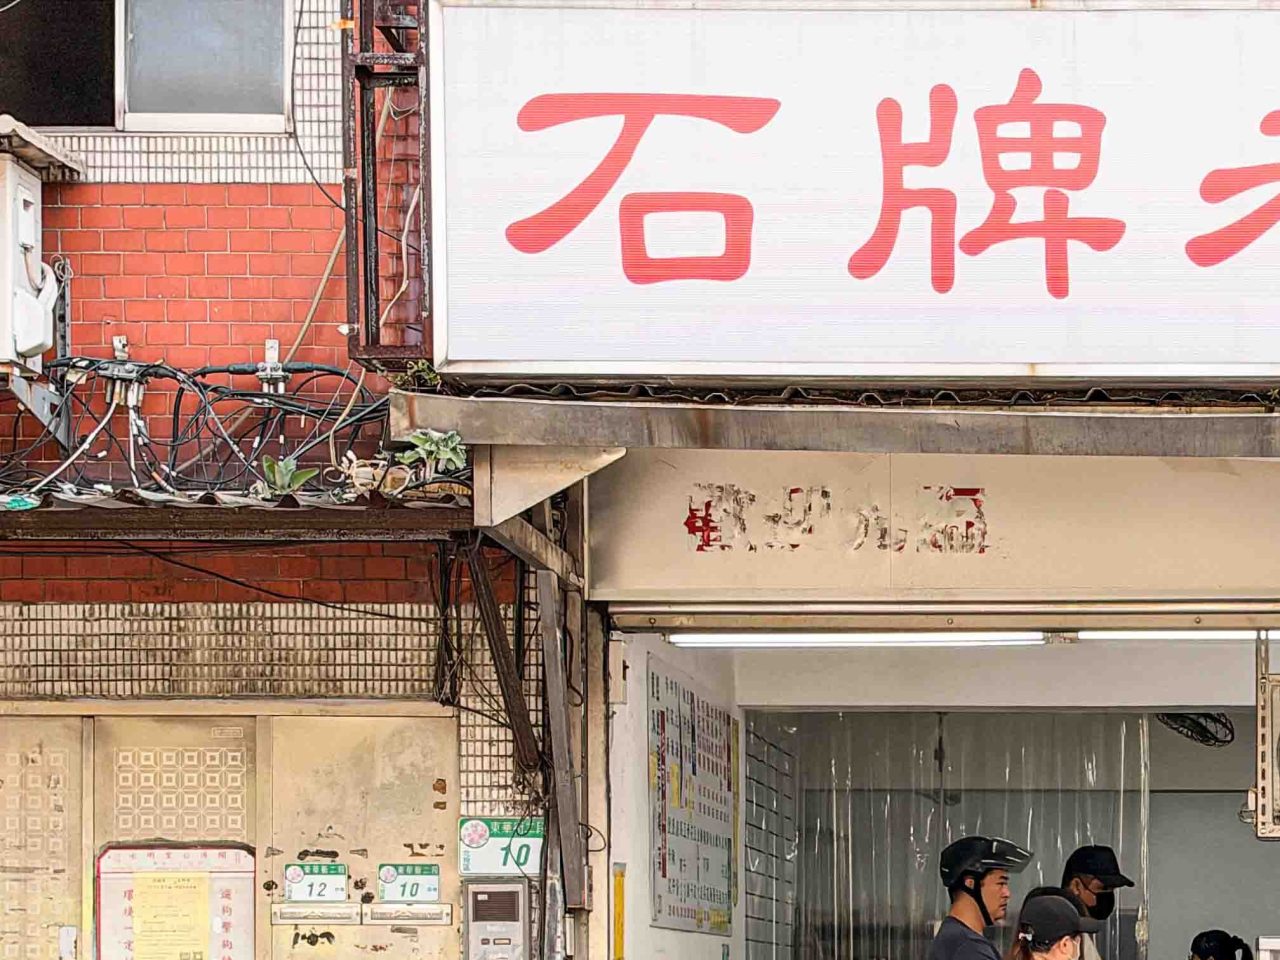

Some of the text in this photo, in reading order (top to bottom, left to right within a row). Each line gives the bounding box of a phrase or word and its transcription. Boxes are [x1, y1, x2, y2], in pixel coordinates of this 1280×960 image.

[500, 843, 531, 867] 10
[307, 882, 328, 898] 12
[399, 882, 420, 898] 10
